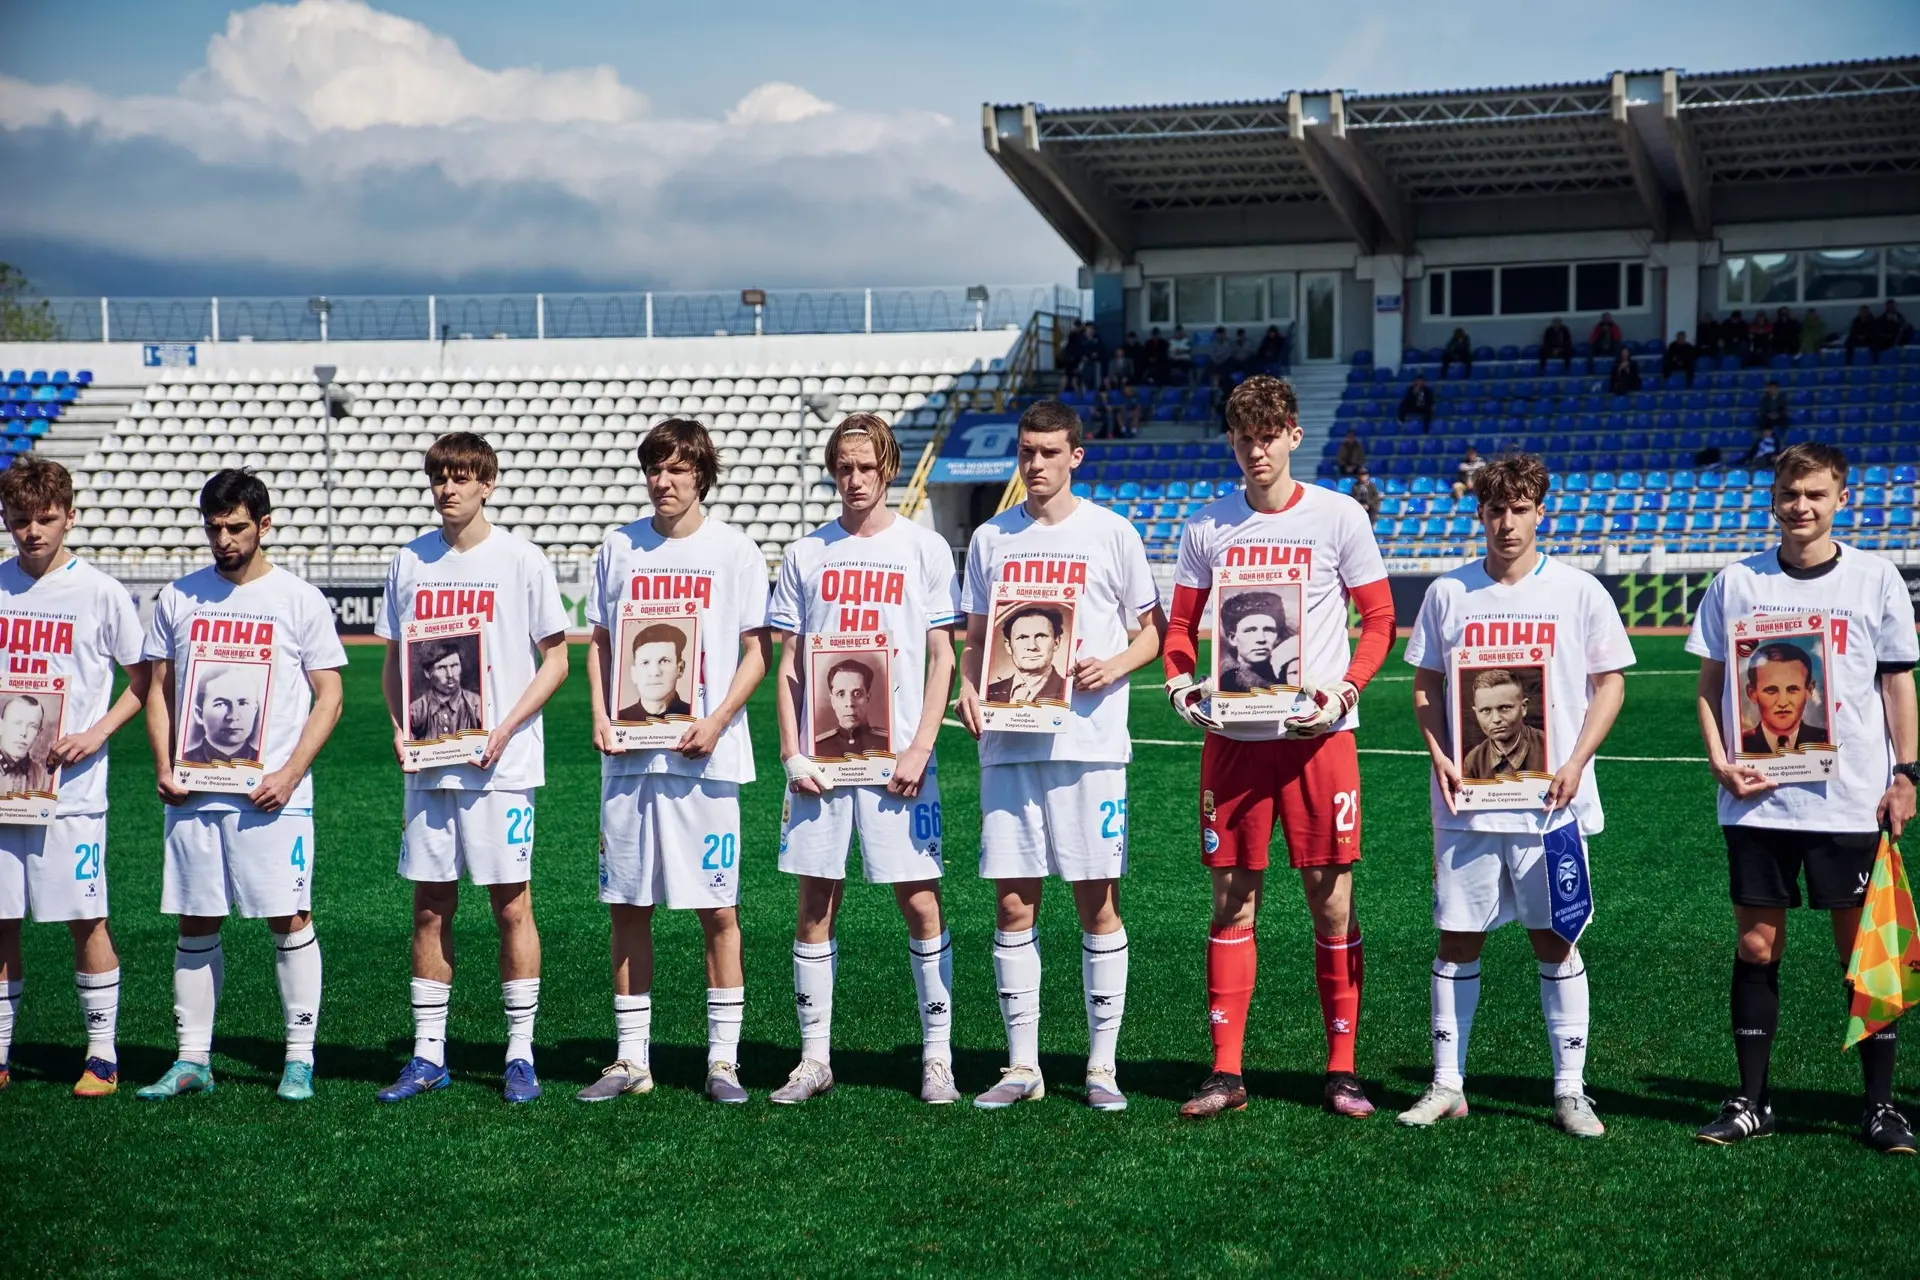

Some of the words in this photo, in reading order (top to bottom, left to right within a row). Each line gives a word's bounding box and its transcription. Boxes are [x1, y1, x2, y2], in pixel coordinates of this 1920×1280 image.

[822, 570, 904, 605] ОДНА
[416, 590, 494, 622] ОДНА
[840, 608, 878, 632] НА
[506, 806, 532, 844] 22
[914, 801, 942, 840] 66
[75, 842, 100, 880] 29
[291, 836, 306, 872] 4
[702, 833, 735, 870] 20
